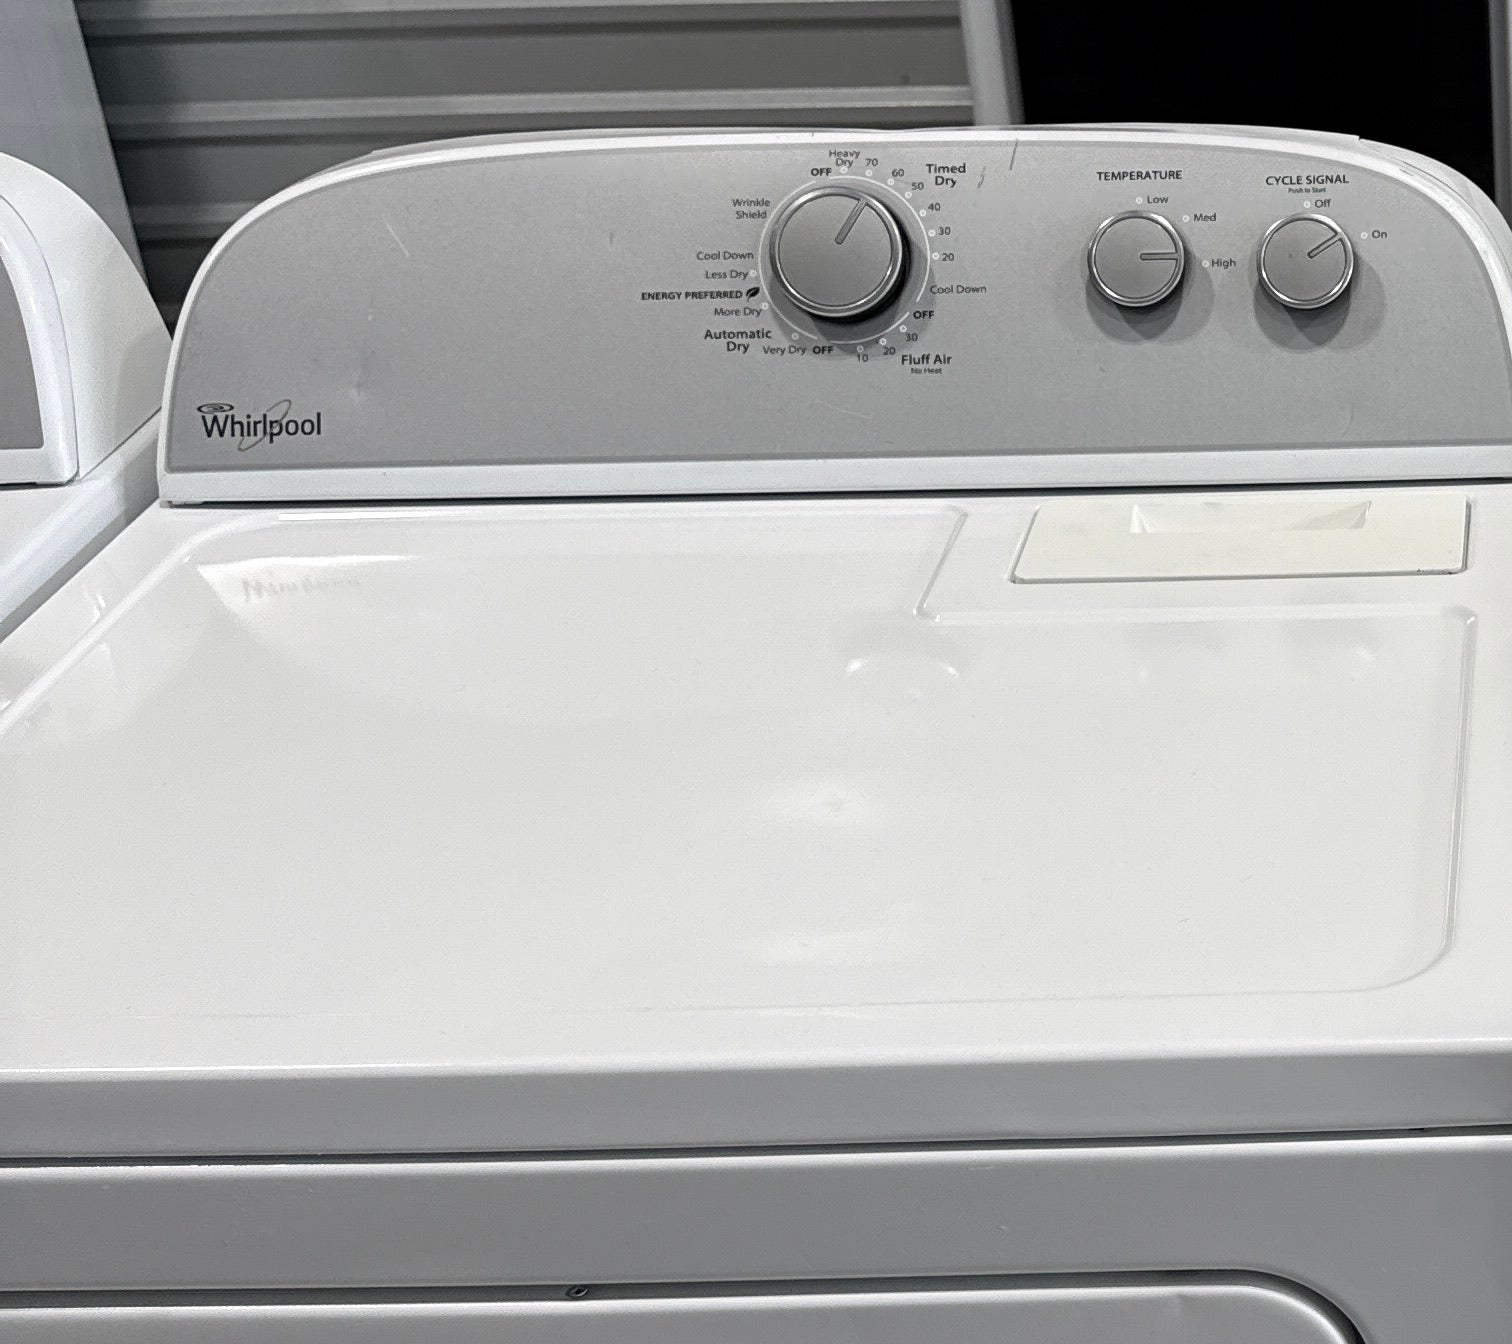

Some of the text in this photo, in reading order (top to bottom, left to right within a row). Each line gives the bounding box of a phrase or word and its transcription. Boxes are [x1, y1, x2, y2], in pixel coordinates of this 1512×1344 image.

[829, 149, 860, 160] Heavy
[835, 158, 854, 168] Dry
[865, 158, 878, 167] 70
[810, 167, 832, 177] OFF
[892, 168, 905, 178] 60
[926, 163, 966, 174] Timed
[1097, 170, 1183, 181] TEMPERATURE
[1266, 175, 1349, 186] CYCLE SIGNAL
[911, 182, 925, 191] 50
[934, 176, 958, 188] Dry
[732, 198, 771, 207] Wrinkle
[1147, 195, 1168, 205] Low
[1315, 199, 1331, 208] Off
[927, 202, 941, 211] 40
[736, 210, 767, 219] Shield
[1194, 213, 1216, 222] Med
[938, 226, 951, 235] 30
[1372, 230, 1387, 239] On
[697, 250, 754, 260] Cool Down
[942, 253, 954, 261] 20
[1212, 258, 1236, 269] High
[705, 269, 749, 282] Less Dry
[930, 284, 987, 294] Cool Down
[641, 290, 743, 301] ENERGY PREFERRED
[714, 307, 762, 319] More Dry
[913, 310, 934, 319] OFF
[704, 328, 772, 341] Automatic
[905, 332, 918, 342] 30
[726, 341, 750, 354] Dry
[763, 345, 806, 357] Very Dry
[812, 345, 834, 355] OFF
[883, 346, 896, 355] 20
[857, 353, 868, 363] 10
[901, 354, 952, 365] Fluff Air
[201, 412, 322, 444] Whirlpool
